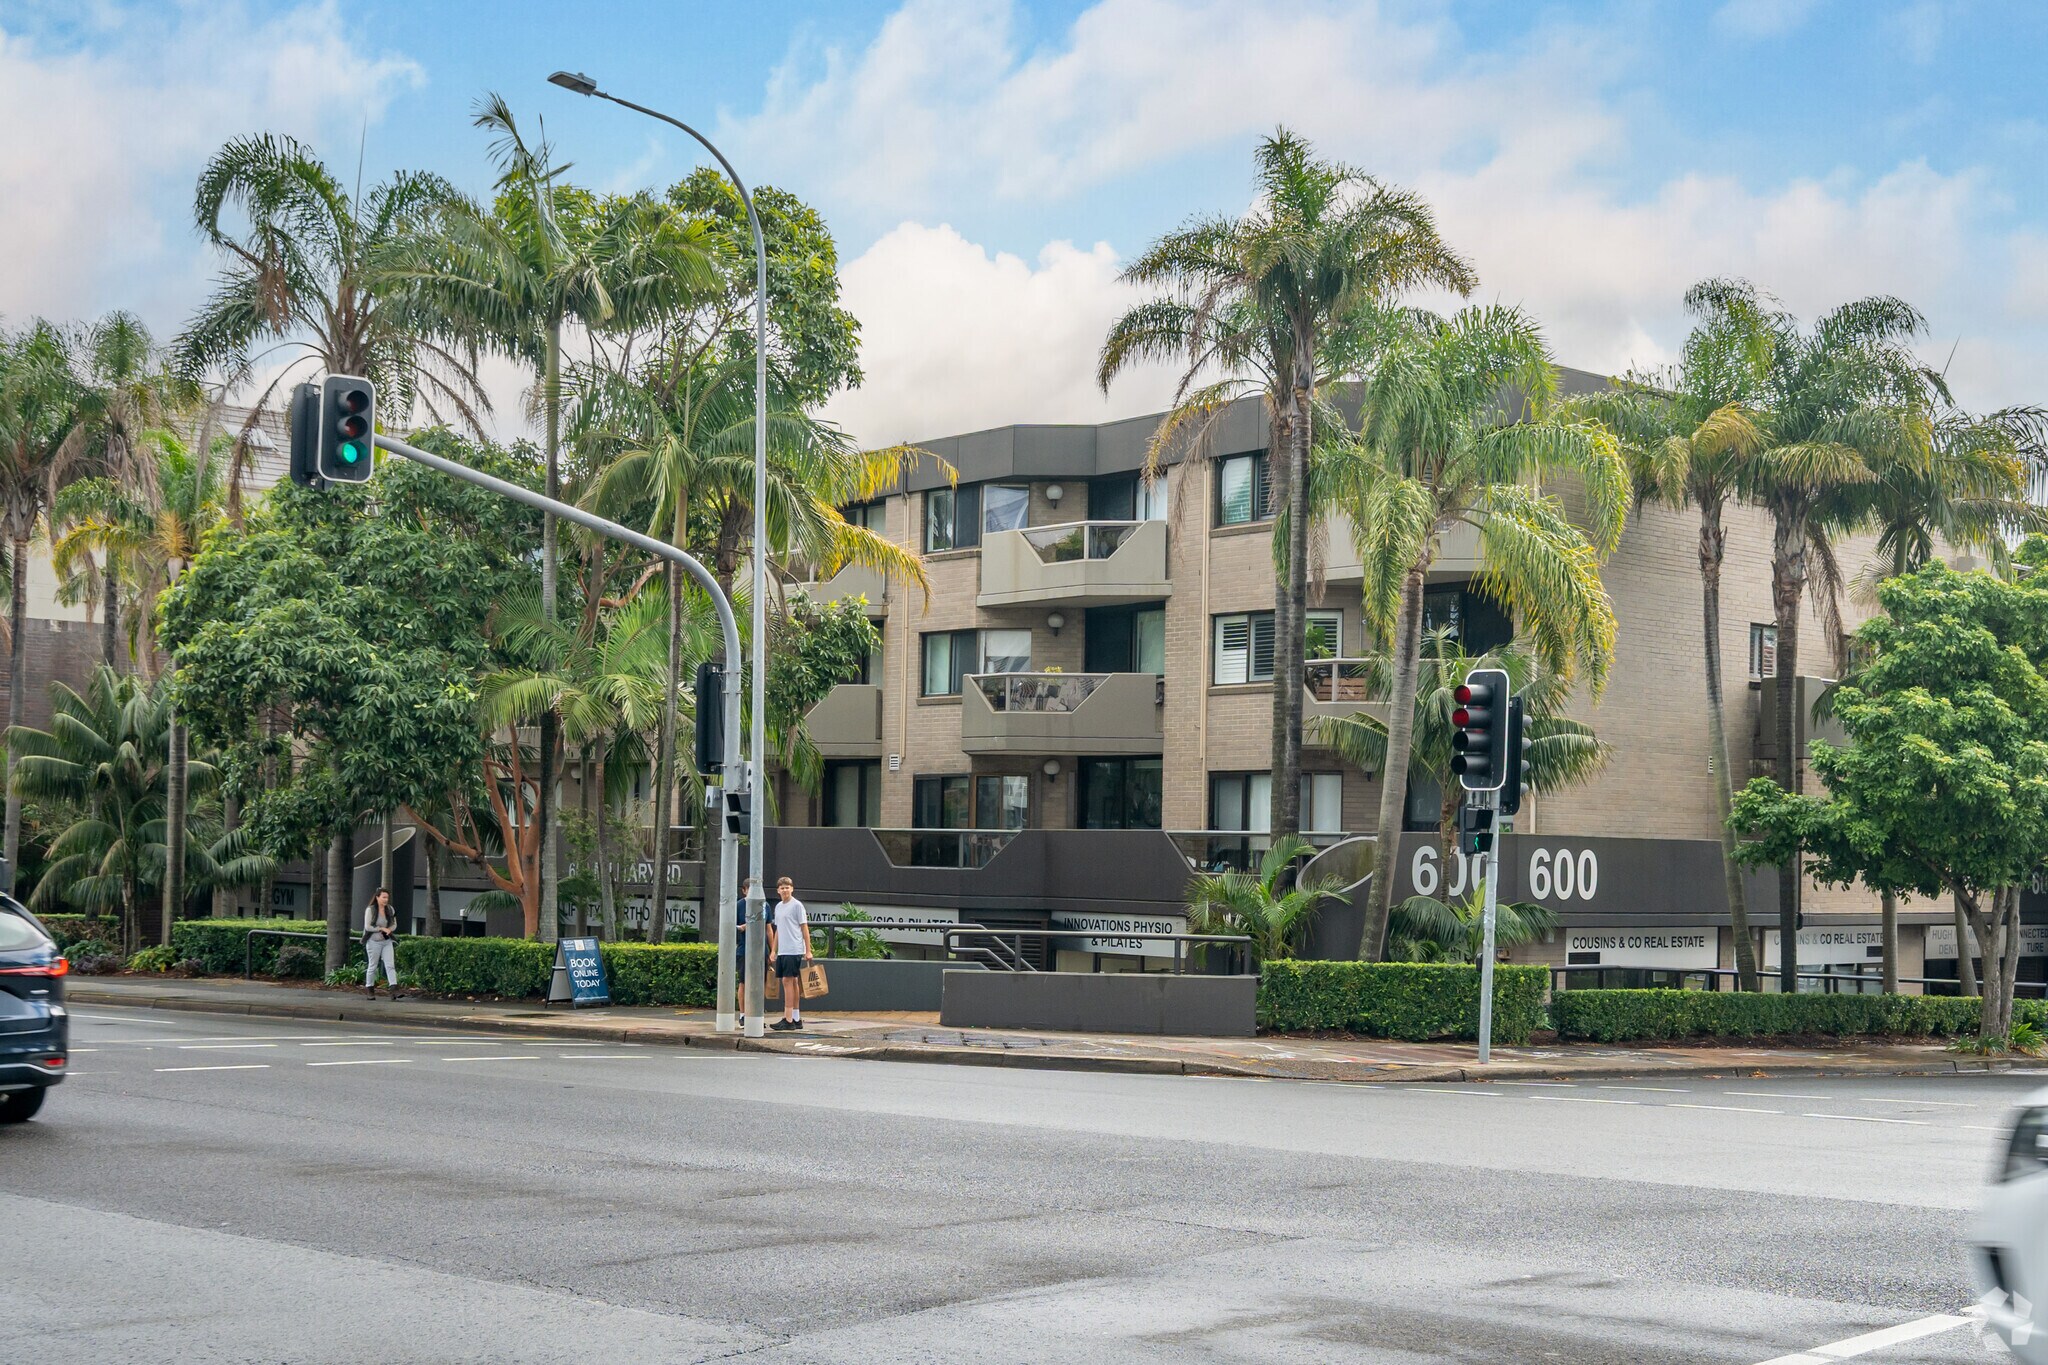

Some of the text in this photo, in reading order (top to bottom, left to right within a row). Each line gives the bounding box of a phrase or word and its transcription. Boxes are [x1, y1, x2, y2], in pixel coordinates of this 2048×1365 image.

[1529, 848, 1598, 900] 600
[273, 888, 295, 906] GYM
[1064, 917, 1172, 934] INNOVATIONS PHYSIO
[1820, 933, 1832, 944] CO
[1834, 933, 1854, 944] REAL
[1857, 932, 1883, 943] ESTATE
[1932, 929, 1953, 940] HUGH
[1091, 937, 1143, 949] & PILATES
[1572, 936, 1705, 949] COUSINS & CO REAL ESTATE
[570, 958, 597, 967] BOOK
[573, 969, 599, 977] ONLINE
